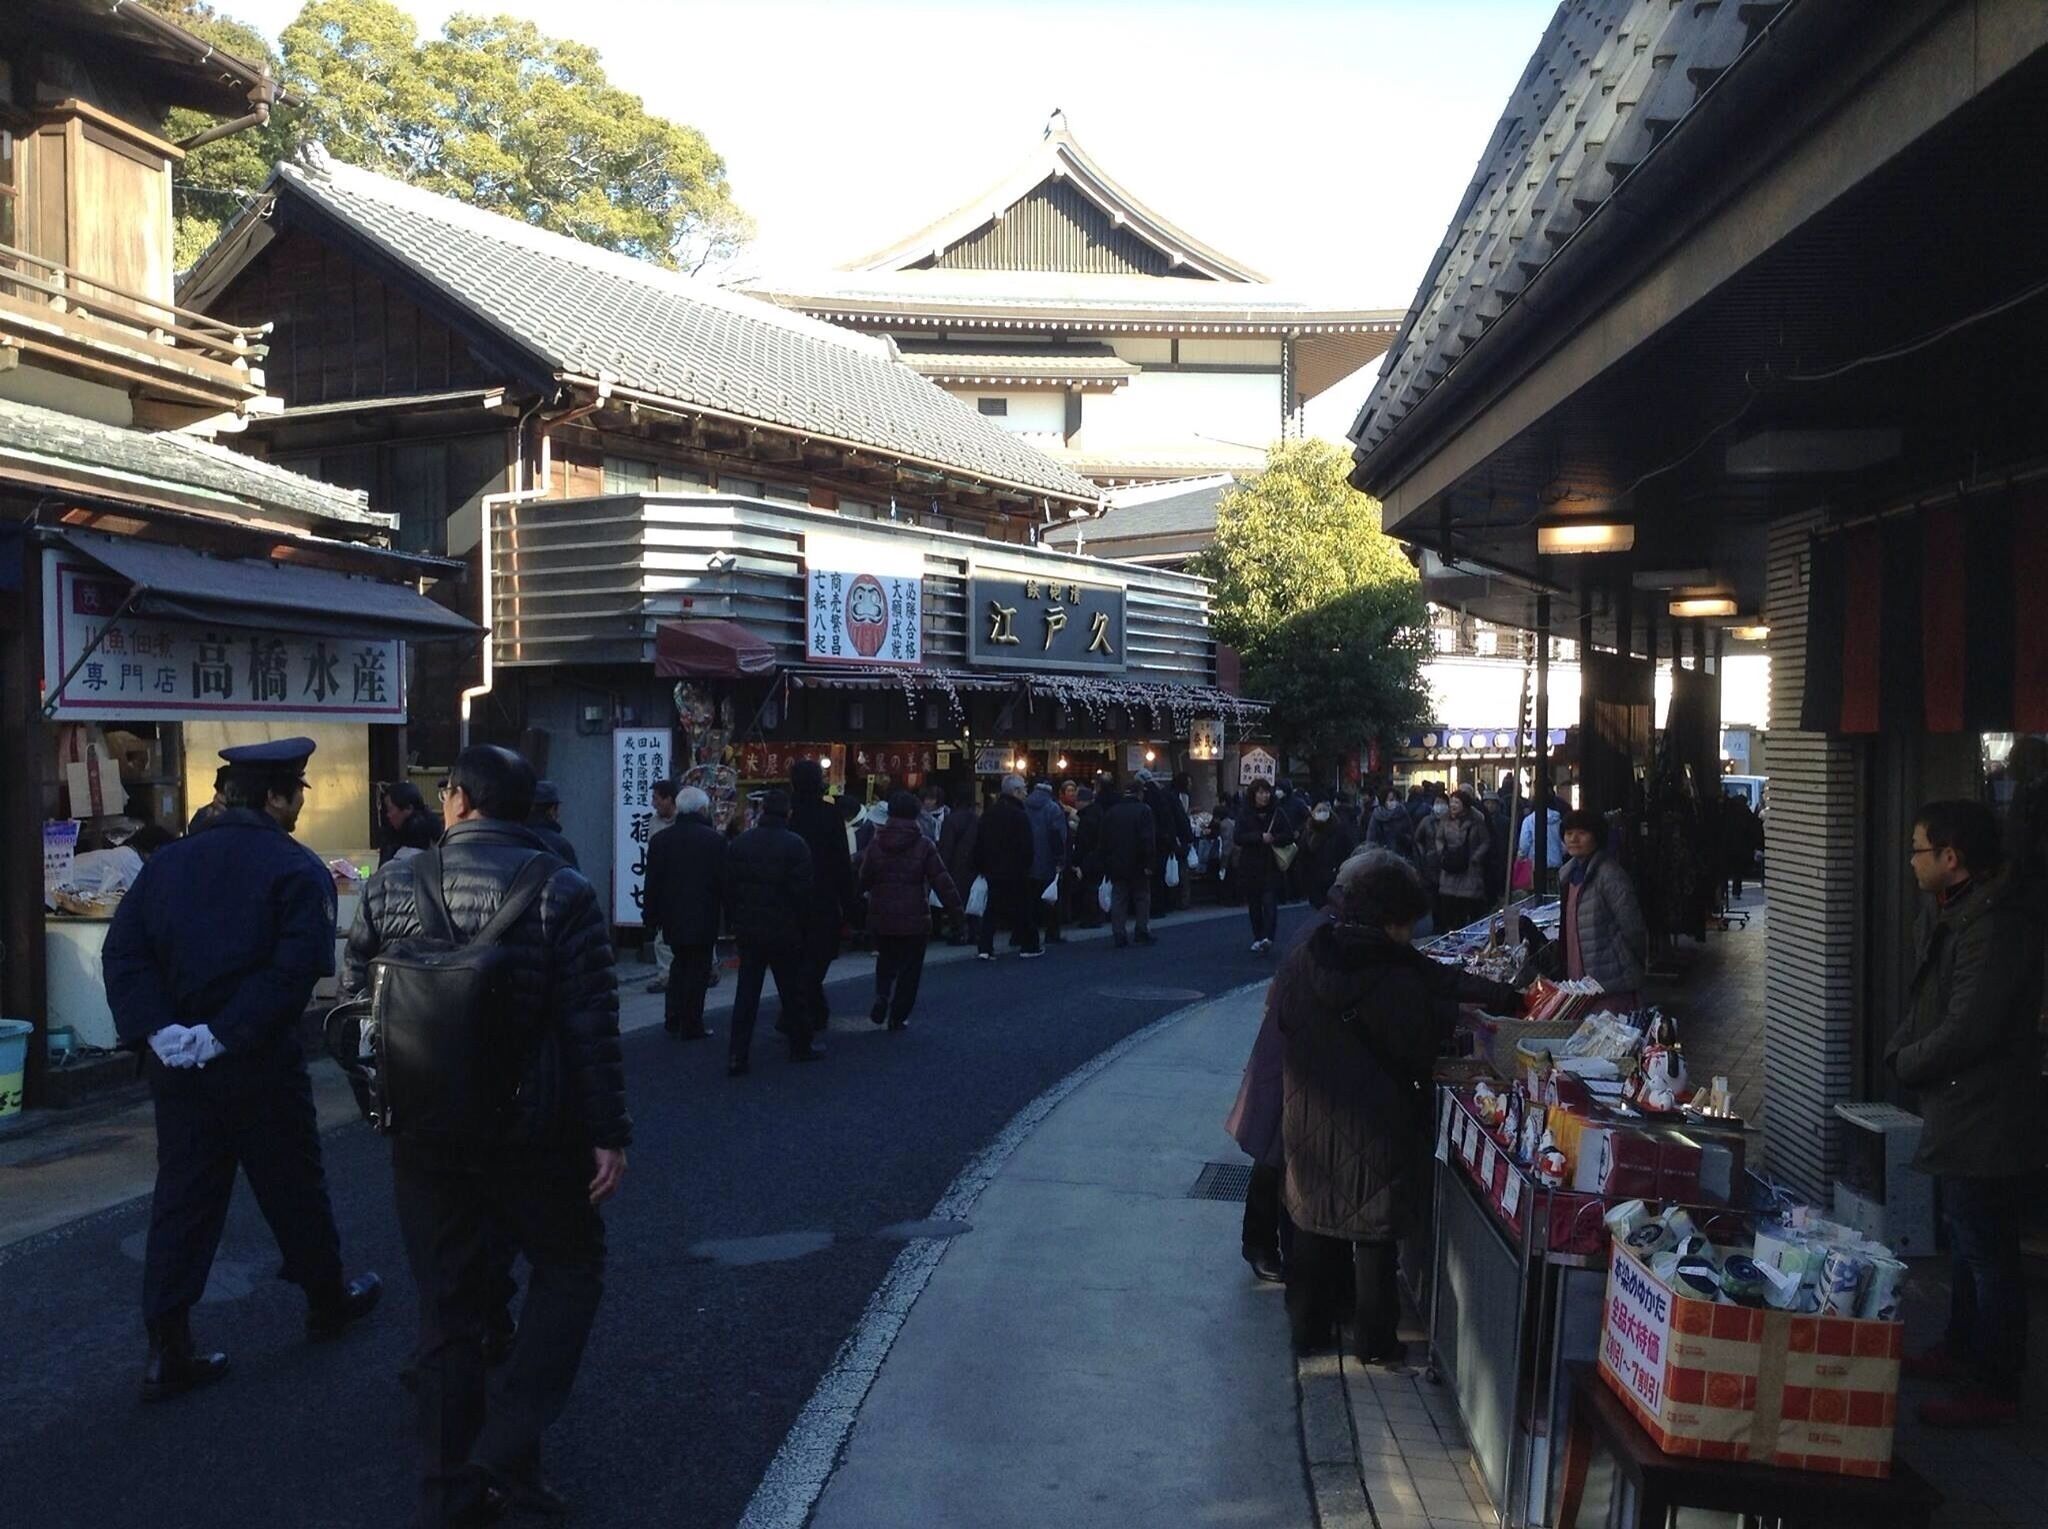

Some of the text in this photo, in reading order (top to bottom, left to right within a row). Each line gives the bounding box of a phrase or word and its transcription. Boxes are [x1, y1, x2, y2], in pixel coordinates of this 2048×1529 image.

[814, 569, 826, 655] 七転八起
[829, 574, 842, 657] 商売繁昌
[892, 579, 903, 660] 大願成就
[905, 583, 916, 660] 必勝合格
[989, 600, 1114, 656] 江戸久
[82, 662, 177, 695] 専門店
[190, 633, 389, 705] 高橋水産
[624, 736, 661, 751] 成田山
[622, 752, 634, 806] 家内安全
[637, 752, 649, 808] 厄除開運
[1611, 1296, 1660, 1365] 全品大特価
